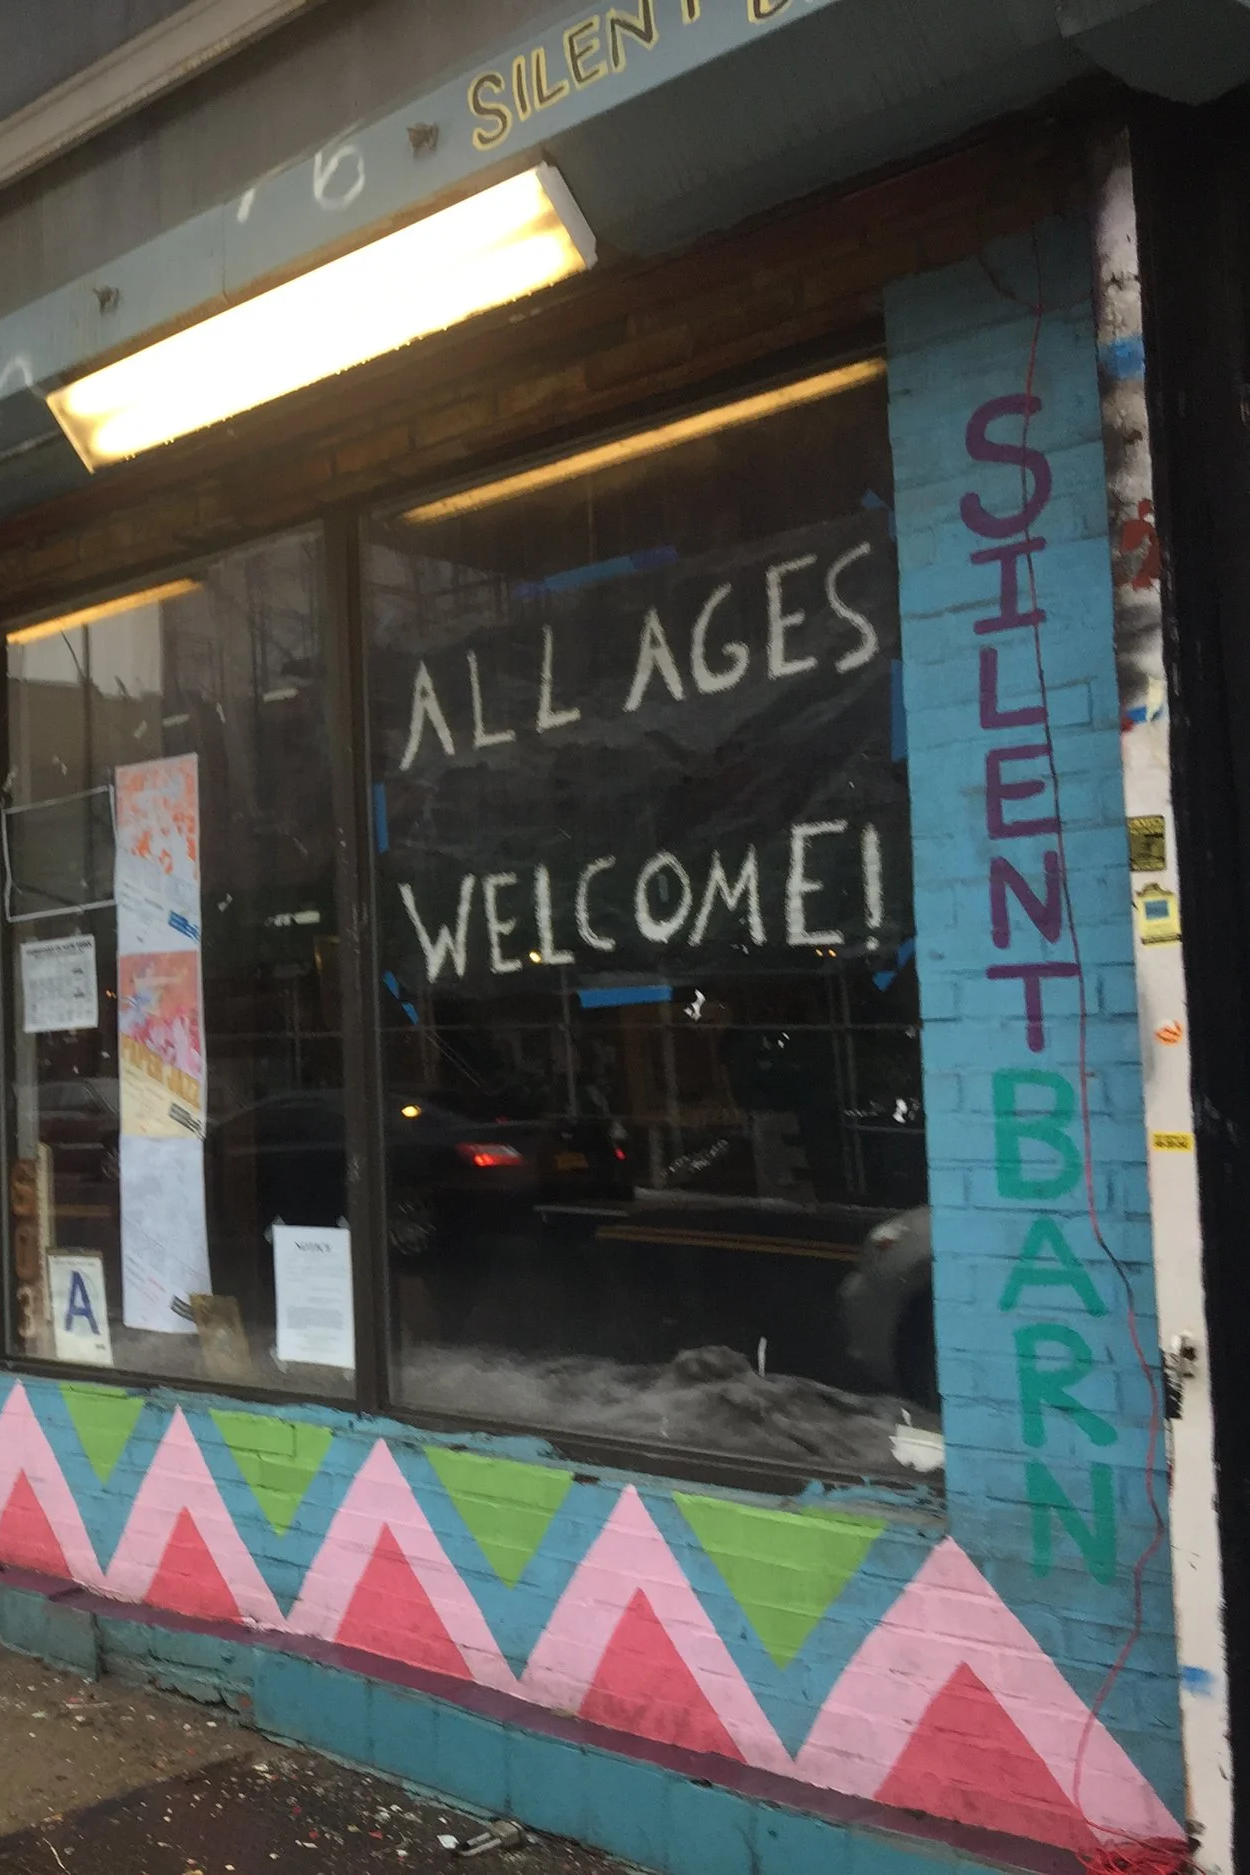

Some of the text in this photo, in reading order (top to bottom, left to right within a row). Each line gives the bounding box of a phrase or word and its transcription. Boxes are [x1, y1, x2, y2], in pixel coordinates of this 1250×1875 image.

[400, 543, 879, 771] ALL AGES
[958, 393, 1082, 1053] SILENT
[399, 819, 885, 984] WELCOME!
[65, 1270, 101, 1336] A
[992, 1066, 1117, 1585] BARN
